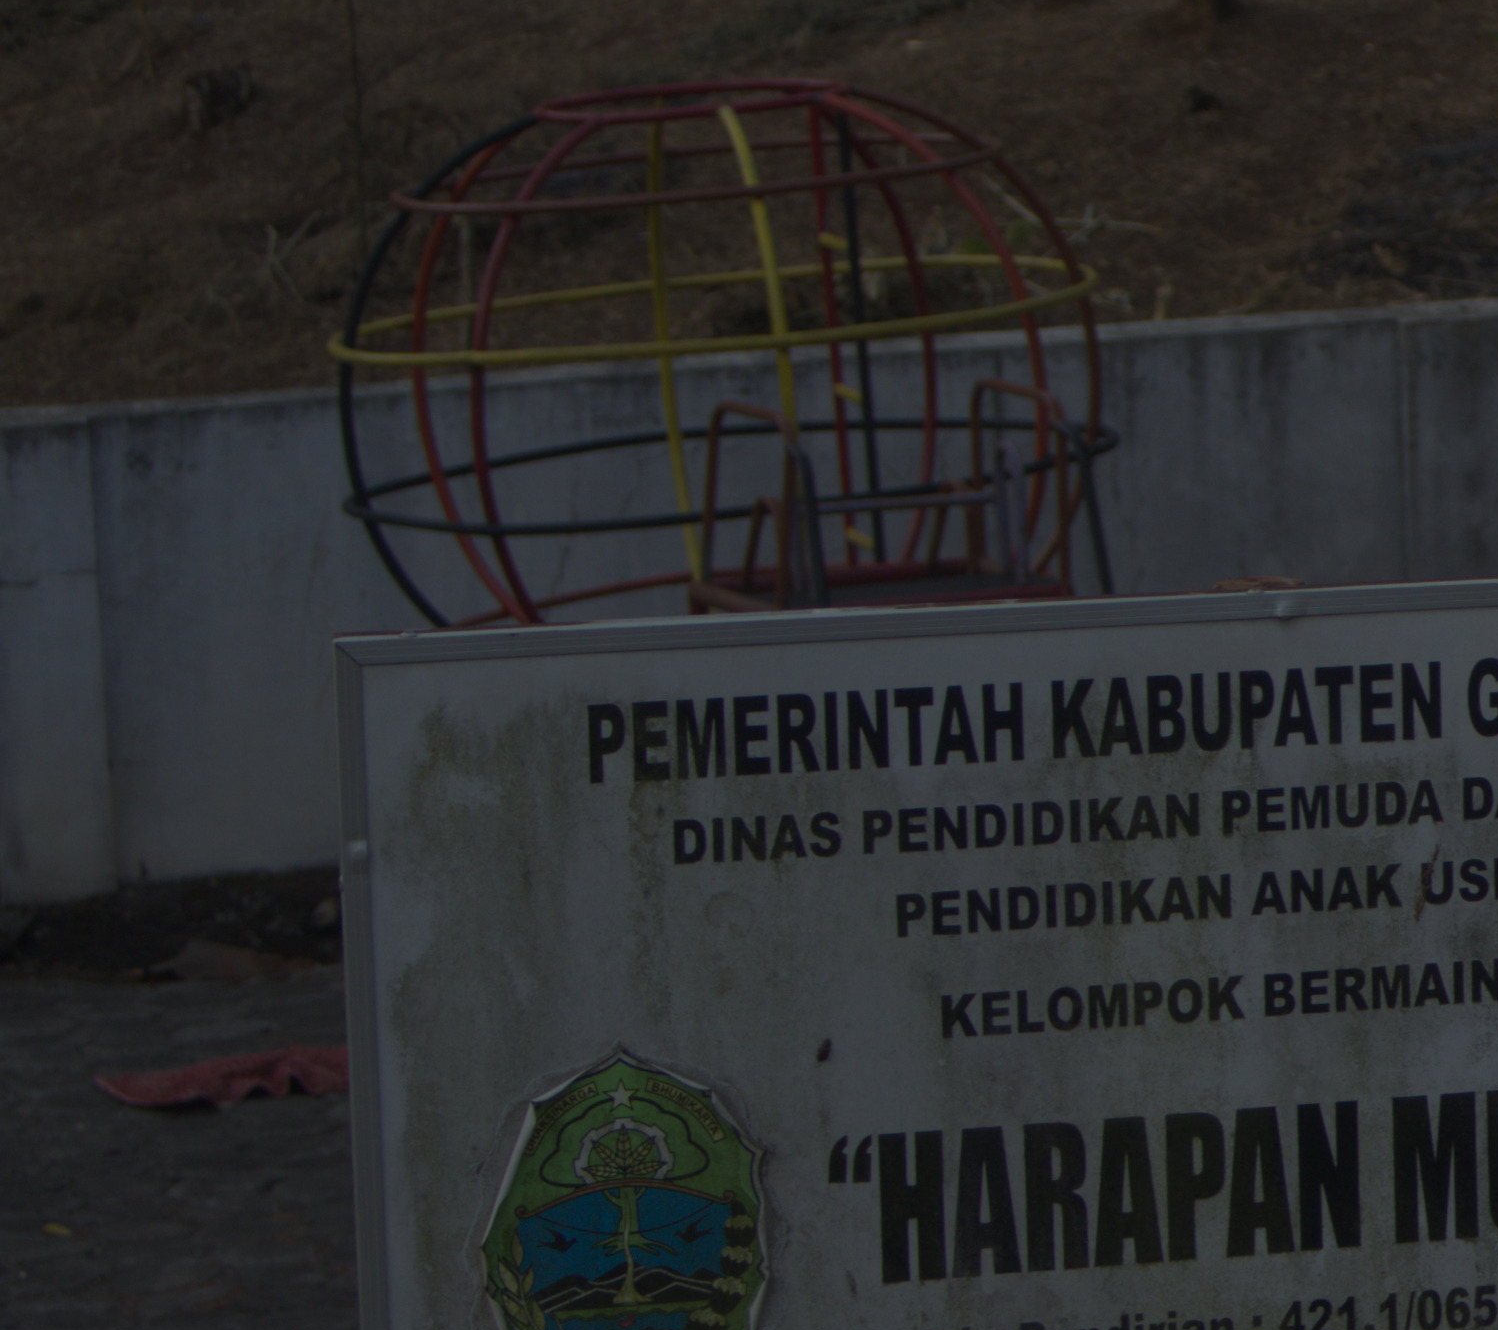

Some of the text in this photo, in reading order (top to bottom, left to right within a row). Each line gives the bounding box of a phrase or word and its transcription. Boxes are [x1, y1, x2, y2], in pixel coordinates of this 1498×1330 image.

[588, 682, 1024, 783] PEMERINTAH
[1050, 660, 1442, 761] KABUPATEN
[672, 810, 842, 866] DINAS
[862, 792, 1201, 855] PENDIDIKAN
[1221, 779, 1444, 839] PEMUDA
[895, 873, 1232, 938] PENDIDIKAN
[1251, 863, 1402, 916] ANAK
[939, 974, 1245, 1041] KELOMPOK
[651, 1082, 719, 1136] BHUMIKARTA
